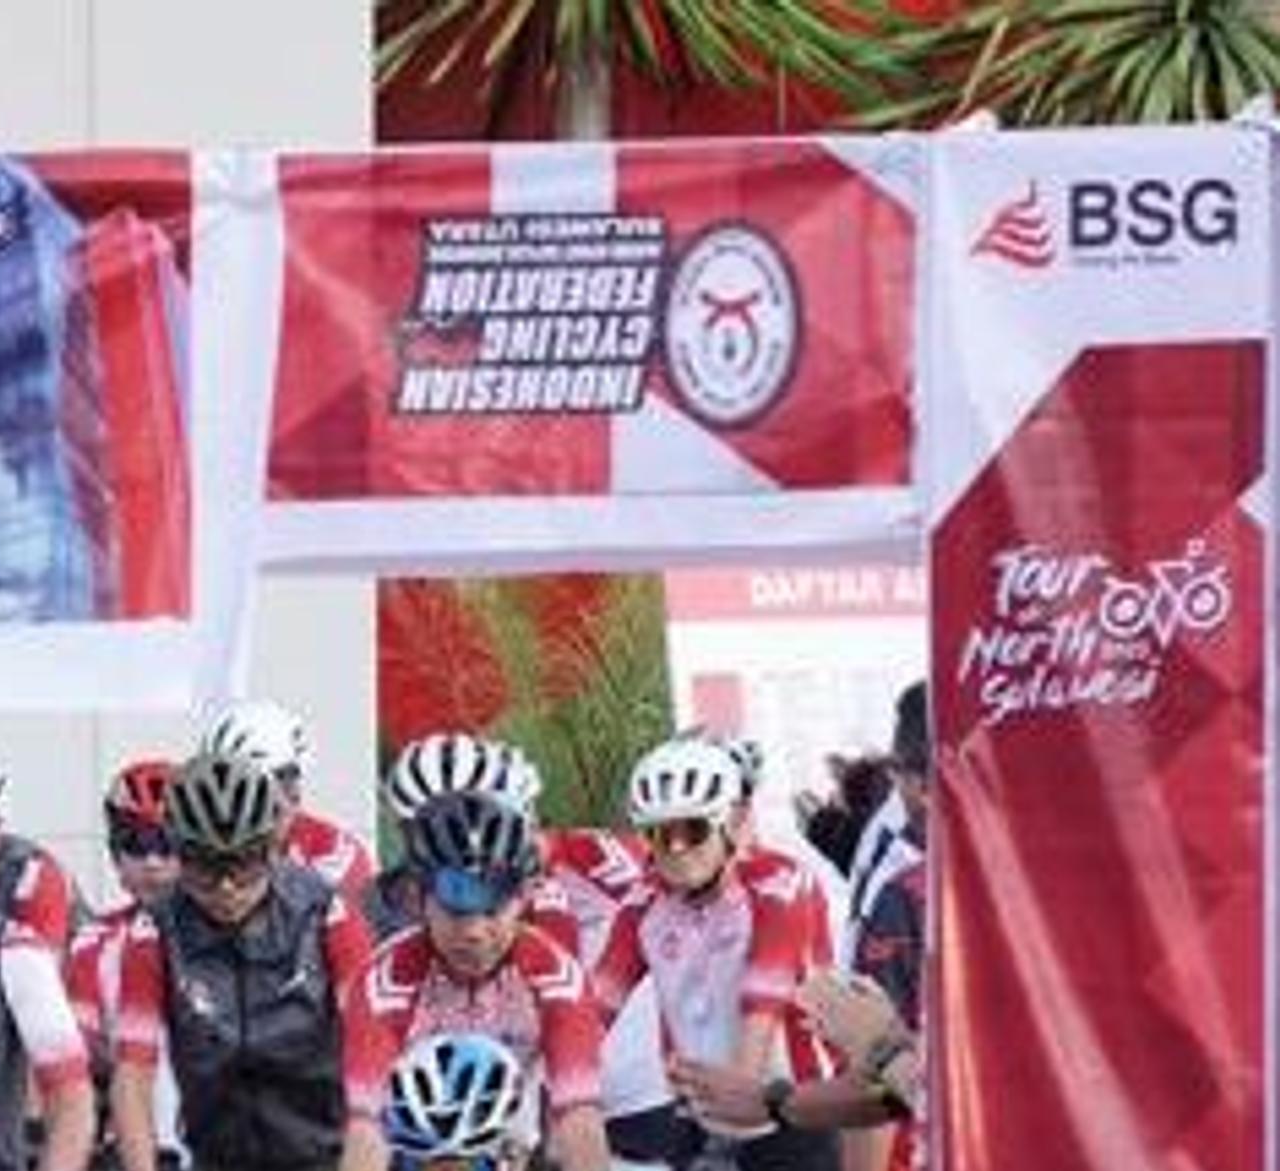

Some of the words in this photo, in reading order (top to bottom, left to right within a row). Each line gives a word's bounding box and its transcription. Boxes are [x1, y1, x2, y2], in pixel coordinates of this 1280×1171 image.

[1070, 179, 1238, 246] BSG
[423, 267, 658, 313] FEDERATION
[482, 314, 653, 360] CYCLING
[401, 366, 645, 410] INDONESIAN
[993, 545, 1111, 617] Tour
[958, 611, 1103, 684] North
